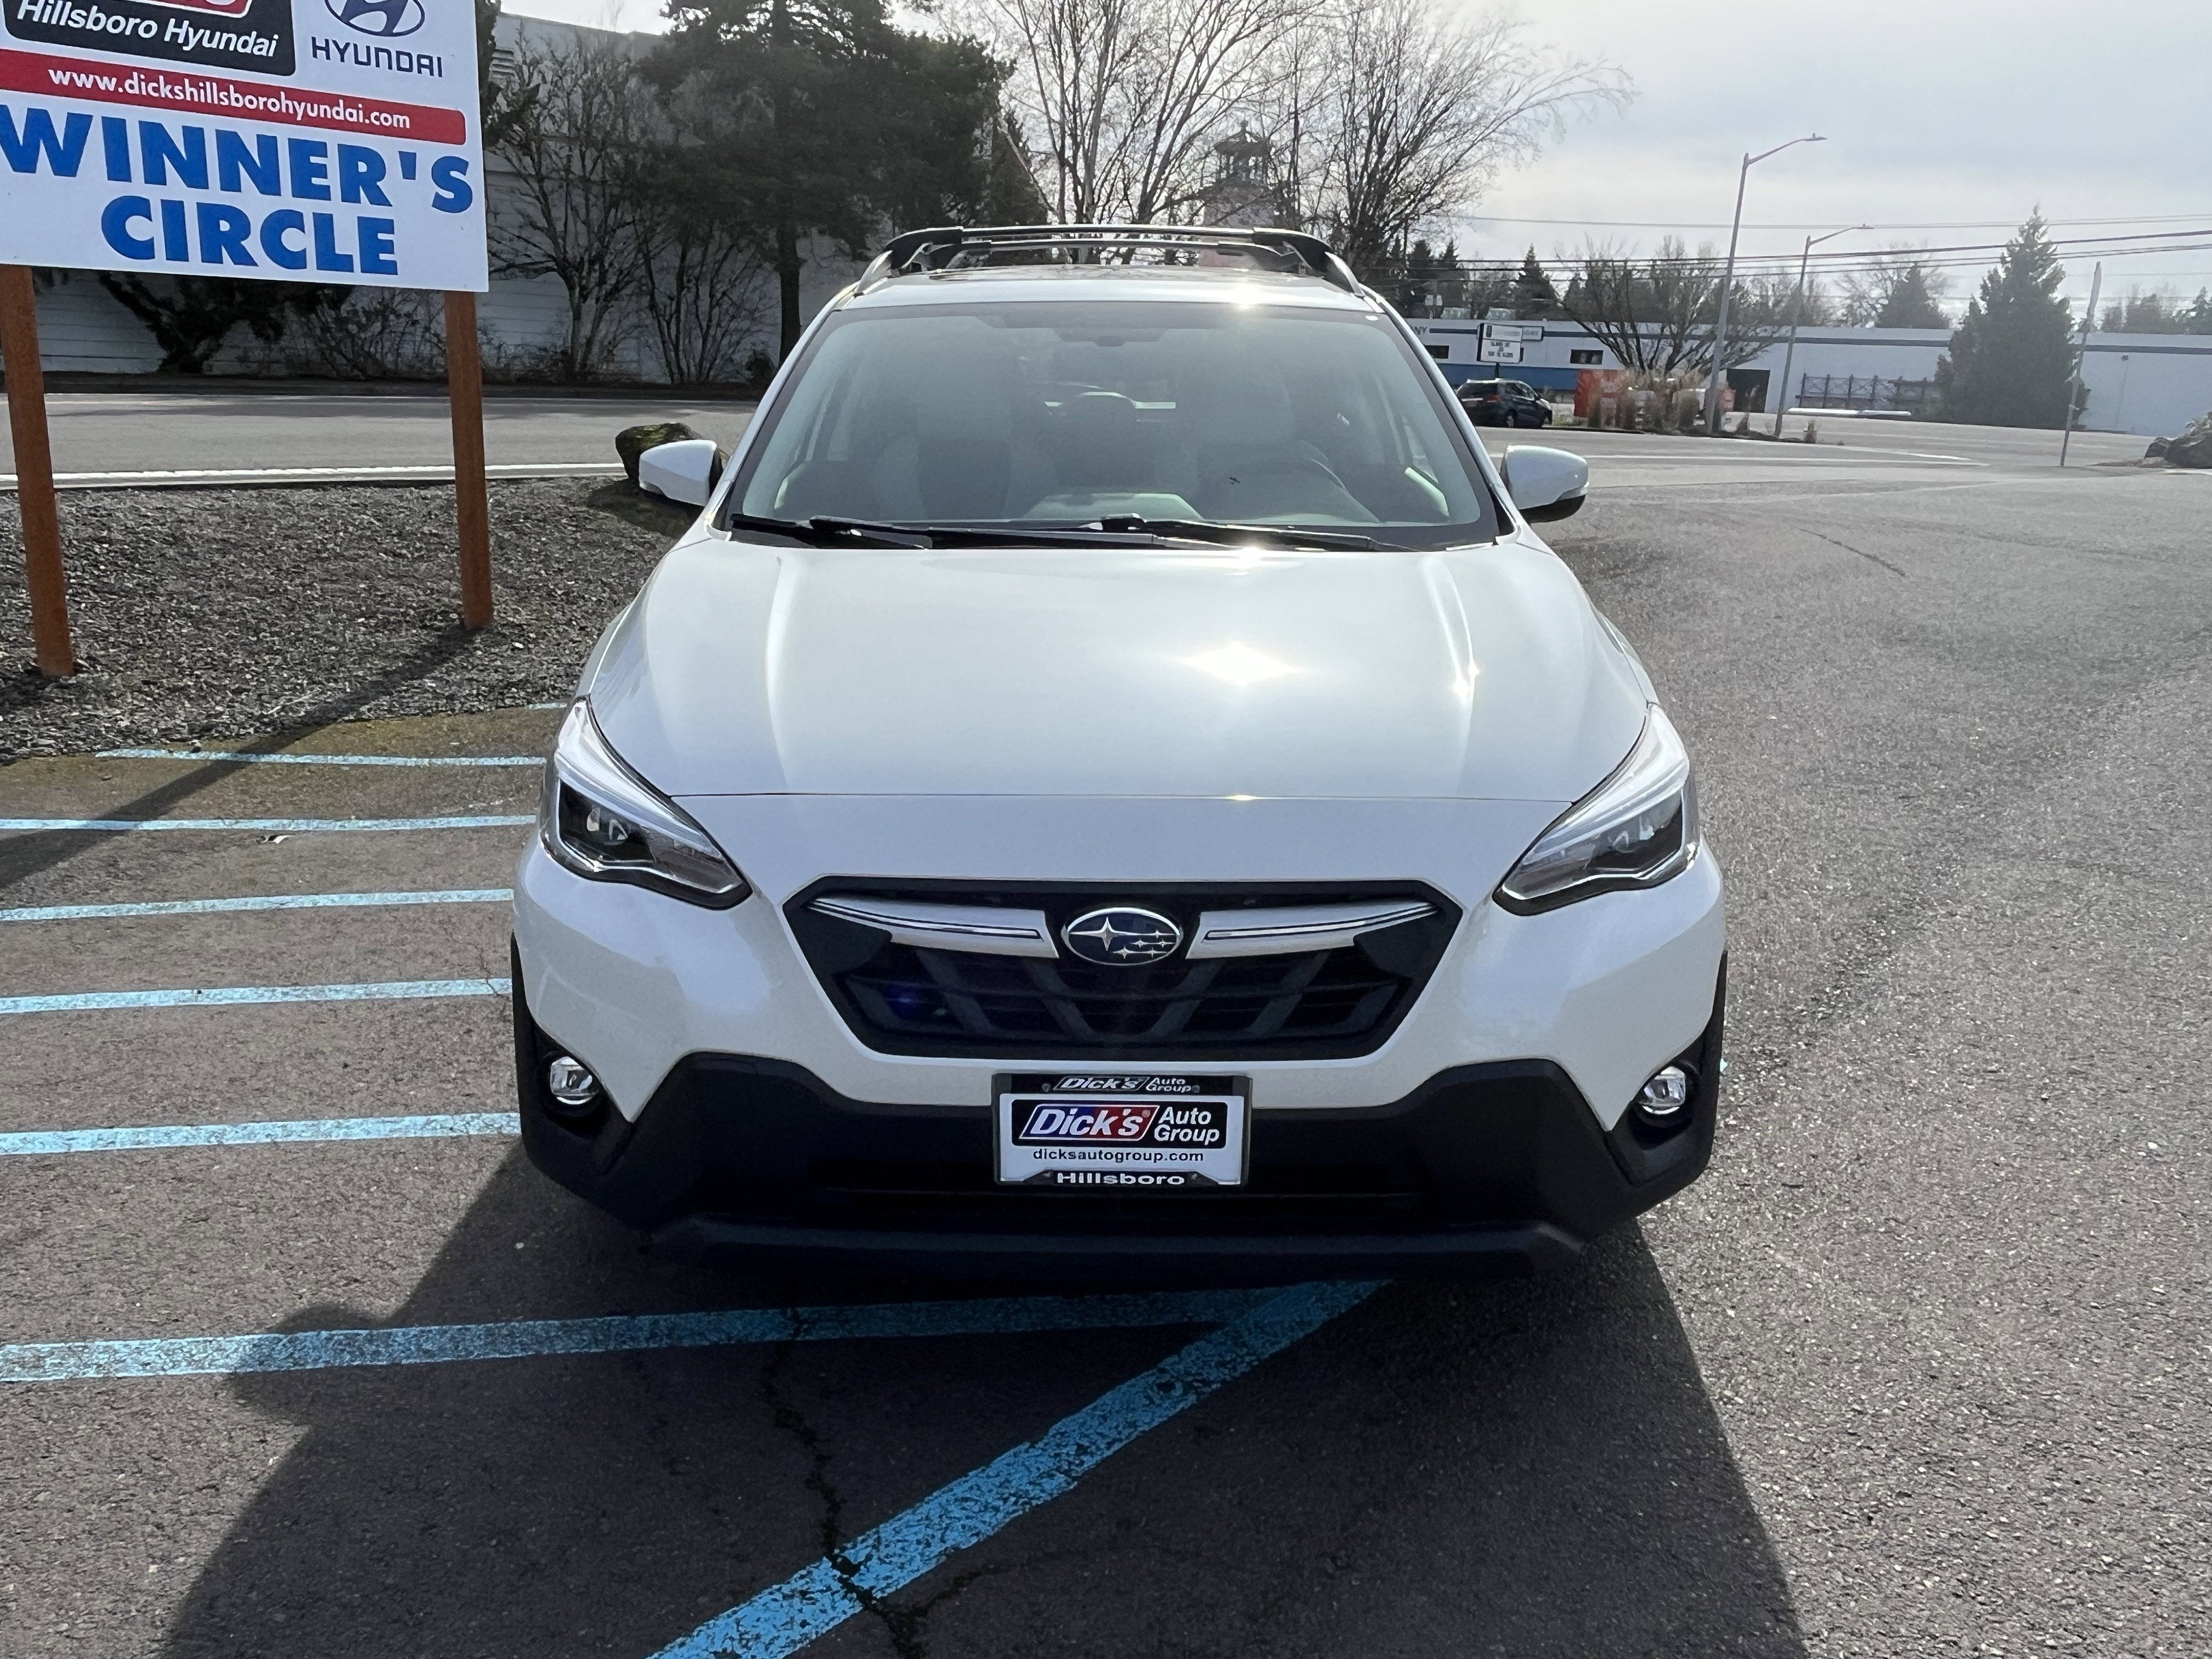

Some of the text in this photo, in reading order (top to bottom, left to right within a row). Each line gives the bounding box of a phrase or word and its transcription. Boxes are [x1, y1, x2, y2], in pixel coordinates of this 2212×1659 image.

[16, 0, 279, 57] Hillsboro Hyundai
[311, 37, 443, 78] HYUNDAI
[48, 66, 410, 129] www.dickshillsborohyundai.com
[0, 104, 473, 213] WINNER'S
[101, 195, 398, 275] CIRCLE
[1060, 1077, 1186, 1090] Dick's Auto
[1146, 1084, 1192, 1093] Group
[1030, 1107, 1212, 1136] Dick's Auto
[1154, 1125, 1220, 1145] Group
[1032, 1149, 1204, 1163] dicksautogroup.com
[1057, 1172, 1185, 1185] Hillsboro
